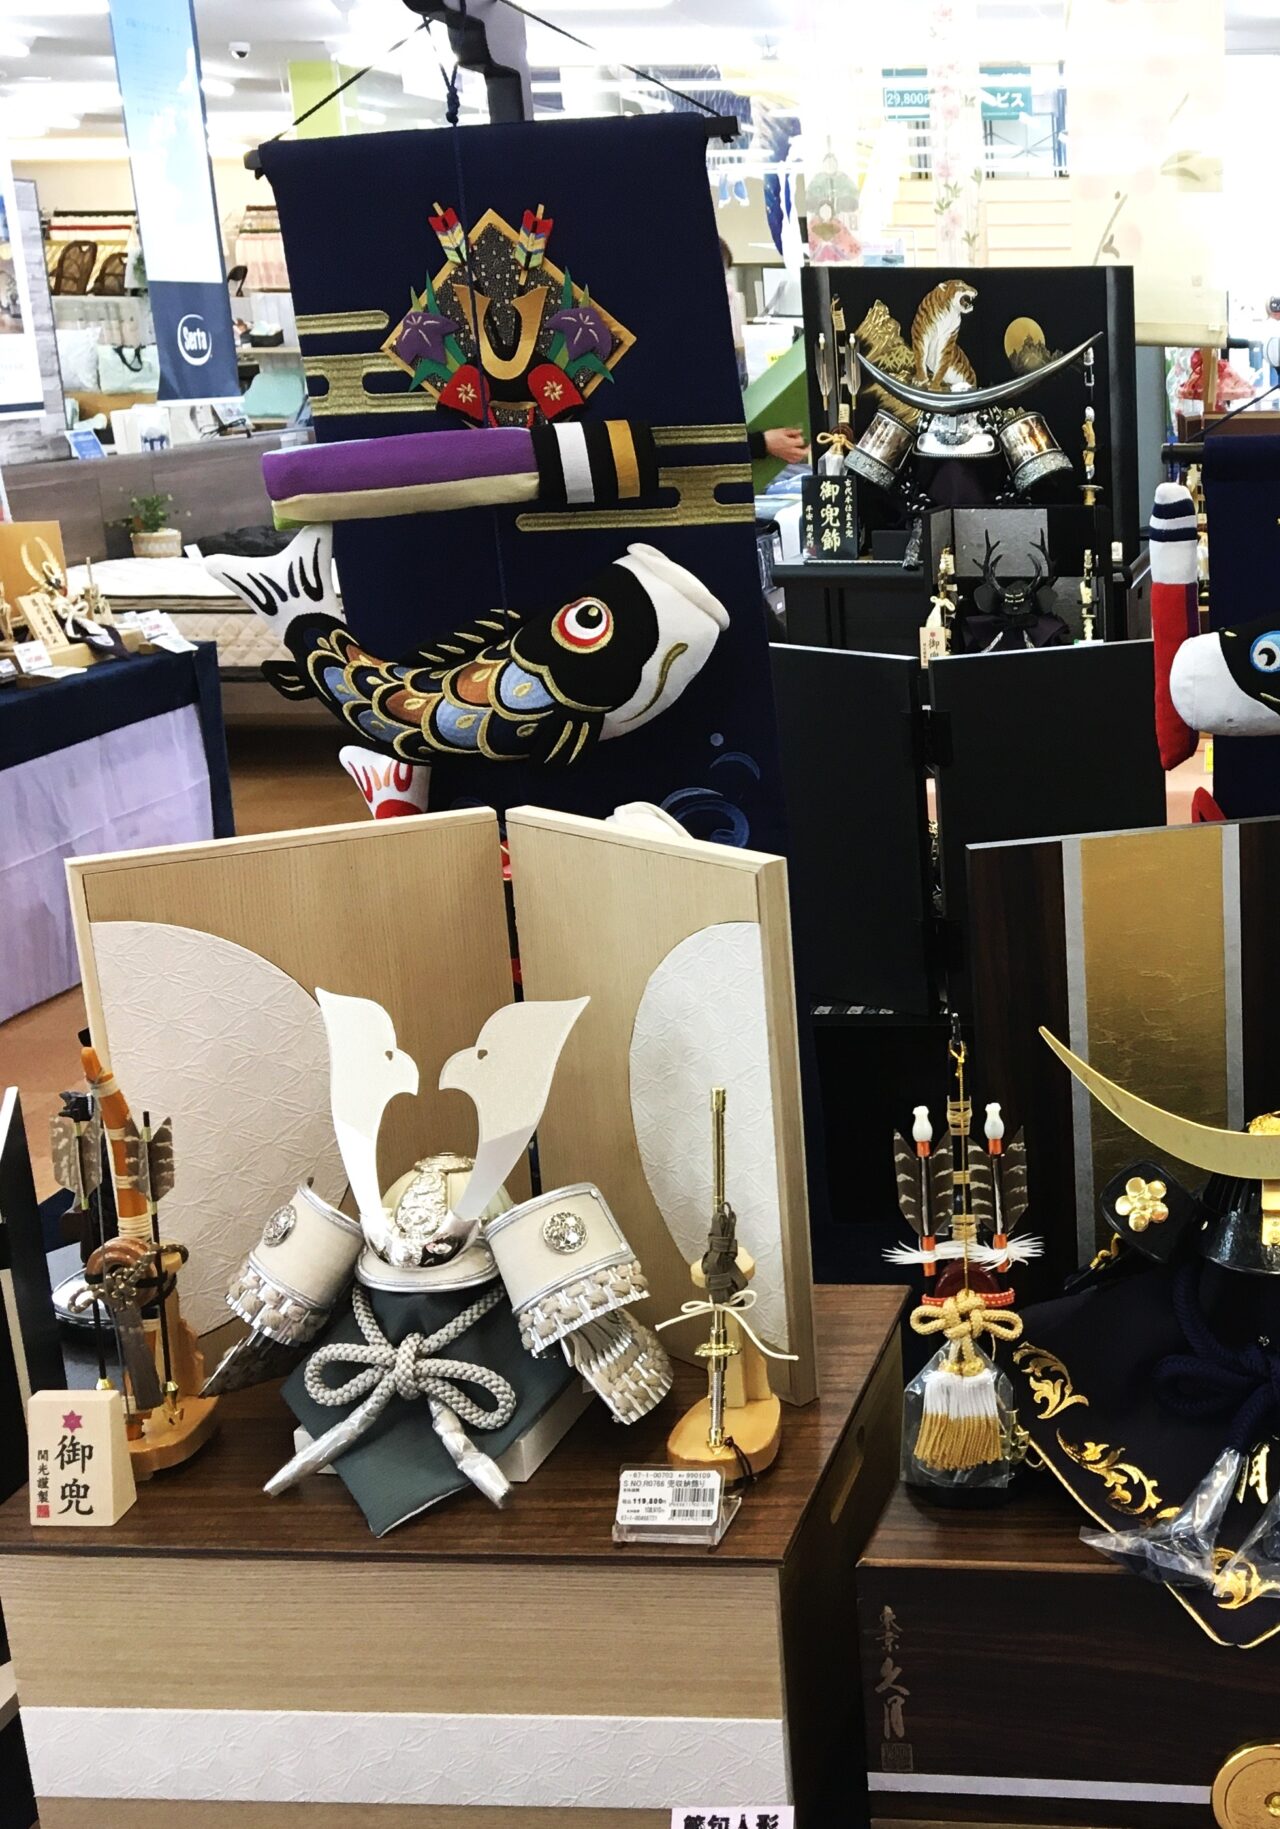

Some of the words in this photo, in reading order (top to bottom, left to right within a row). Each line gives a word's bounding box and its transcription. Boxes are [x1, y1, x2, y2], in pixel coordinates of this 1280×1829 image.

[183, 326, 207, 351] Serta
[820, 480, 841, 553] 御兜飾
[54, 1435, 94, 1515] 御兜
